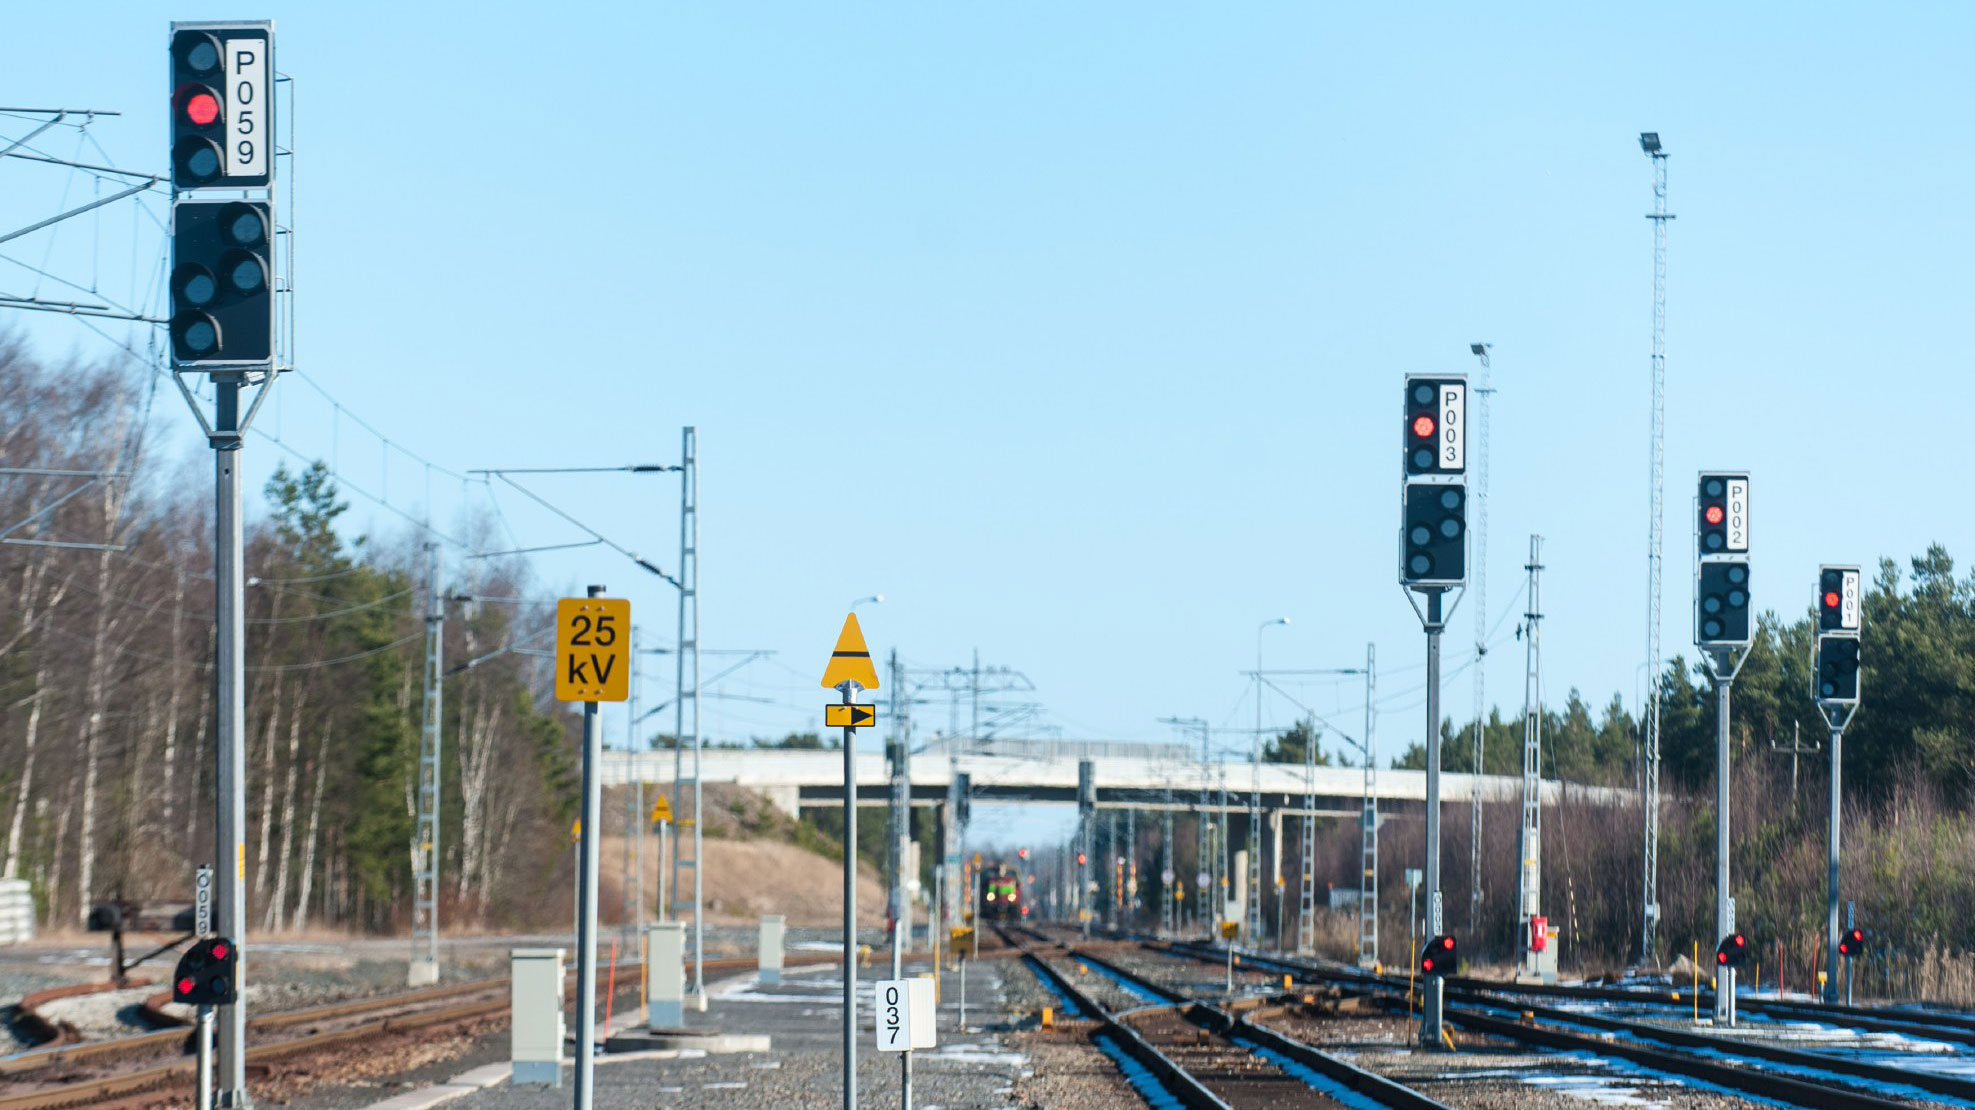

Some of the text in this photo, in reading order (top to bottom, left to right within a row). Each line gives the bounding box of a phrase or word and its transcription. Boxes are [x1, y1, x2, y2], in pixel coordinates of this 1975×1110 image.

[236, 51, 255, 164] P059
[1445, 391, 1458, 461] P003
[1732, 485, 1743, 544] P002
[1846, 576, 1855, 623] P001
[570, 615, 616, 647] 25
[568, 653, 616, 684] kV
[886, 986, 900, 1045] 037
